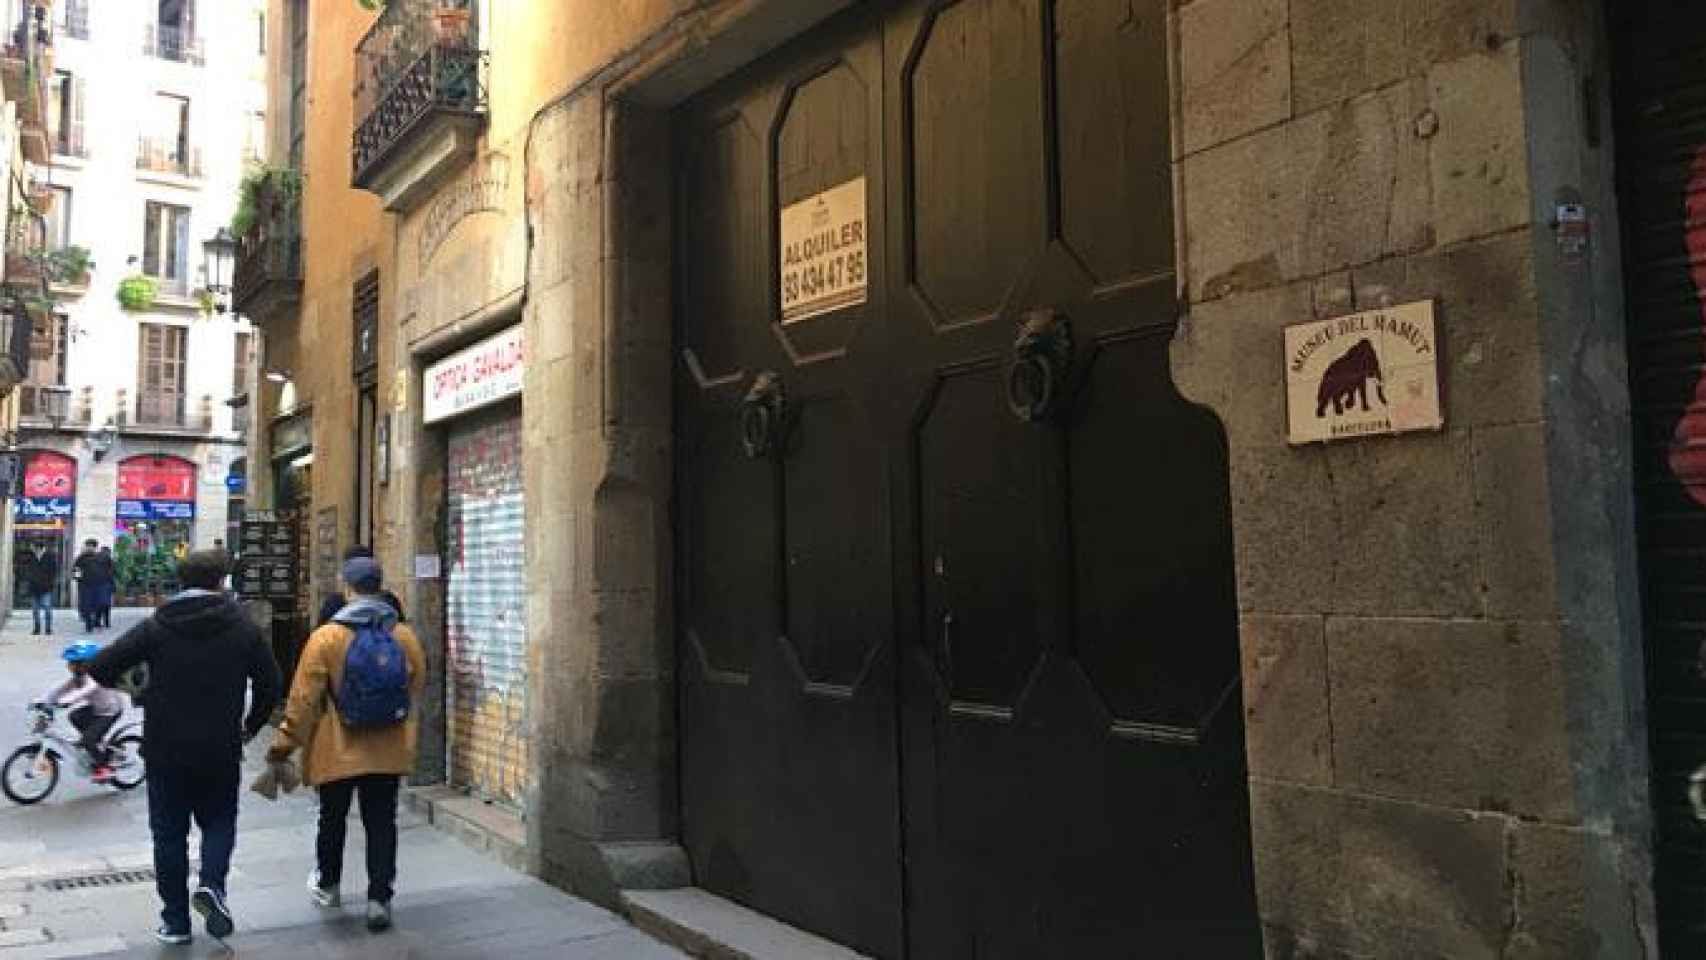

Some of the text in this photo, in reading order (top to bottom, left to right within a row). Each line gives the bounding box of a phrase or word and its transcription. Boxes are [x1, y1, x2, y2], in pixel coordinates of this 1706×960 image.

[785, 220, 864, 265] ALQUILER
[1291, 314, 1431, 372] MUSEU DEL MAMUT
